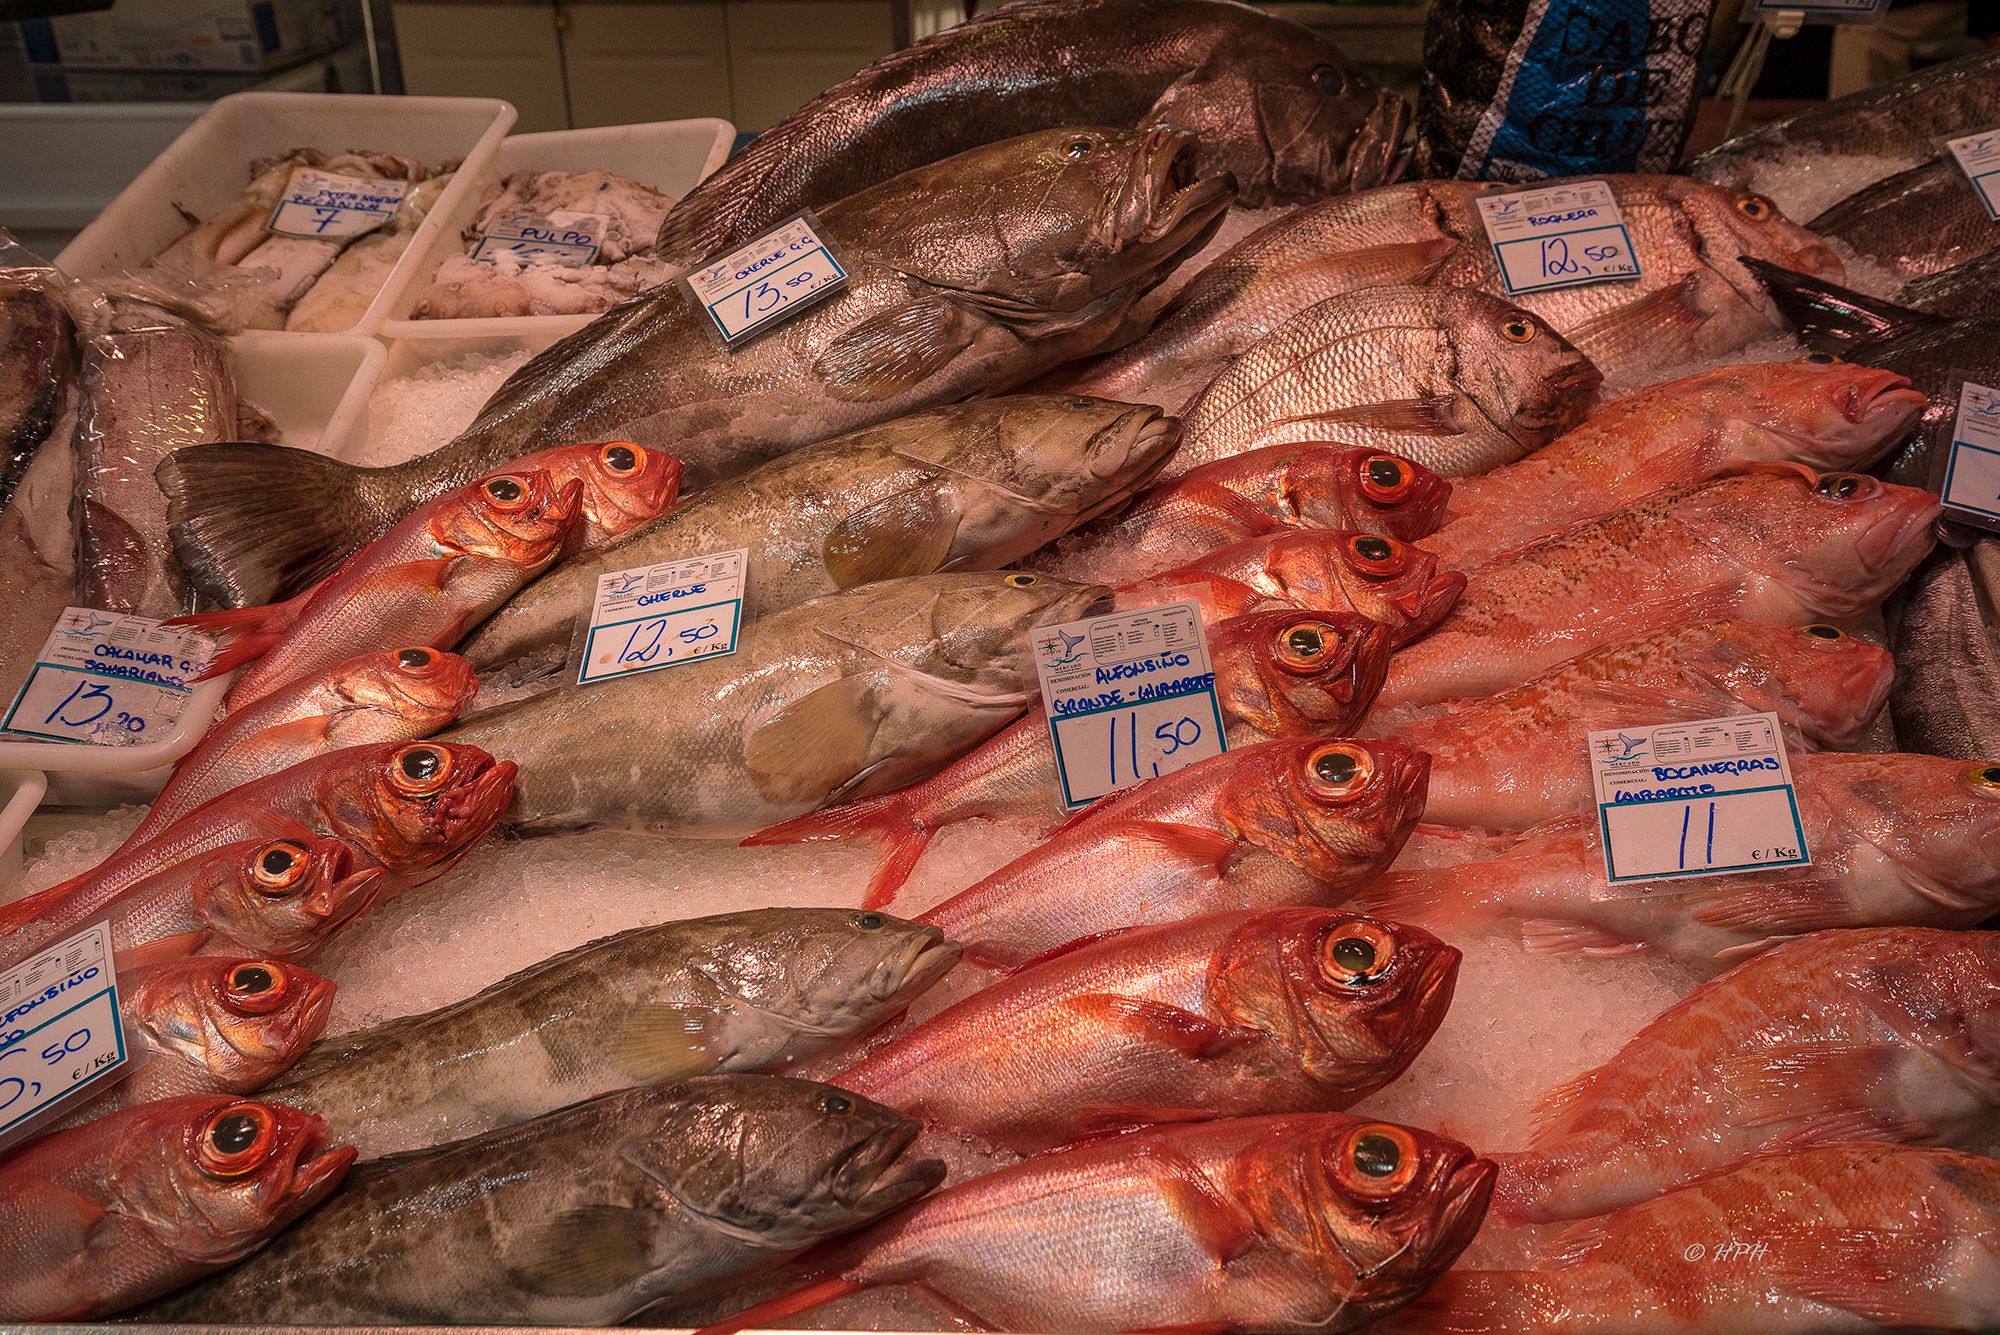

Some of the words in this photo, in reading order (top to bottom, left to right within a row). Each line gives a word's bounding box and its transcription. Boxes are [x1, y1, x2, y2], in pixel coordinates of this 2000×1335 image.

[311, 208, 342, 233] 7
[520, 227, 592, 245] PULPO
[1527, 209, 1598, 227] ROQUERA
[1541, 238, 1618, 278] 12,50
[744, 271, 813, 319] 13,50
[617, 619, 718, 664] 12,50
[1050, 671, 1092, 684] DENOMINACIÓN
[1095, 651, 1190, 685] ALFONSIÑO
[1053, 689, 1125, 716] GRANDE
[1110, 712, 1201, 785] 11,50
[1604, 768, 1650, 777] DENOMINACIÓN
[1650, 757, 1780, 782] BOCANEGRAS
[1679, 802, 1715, 869] 11
[0, 967, 99, 1028] LFONSIÑO
